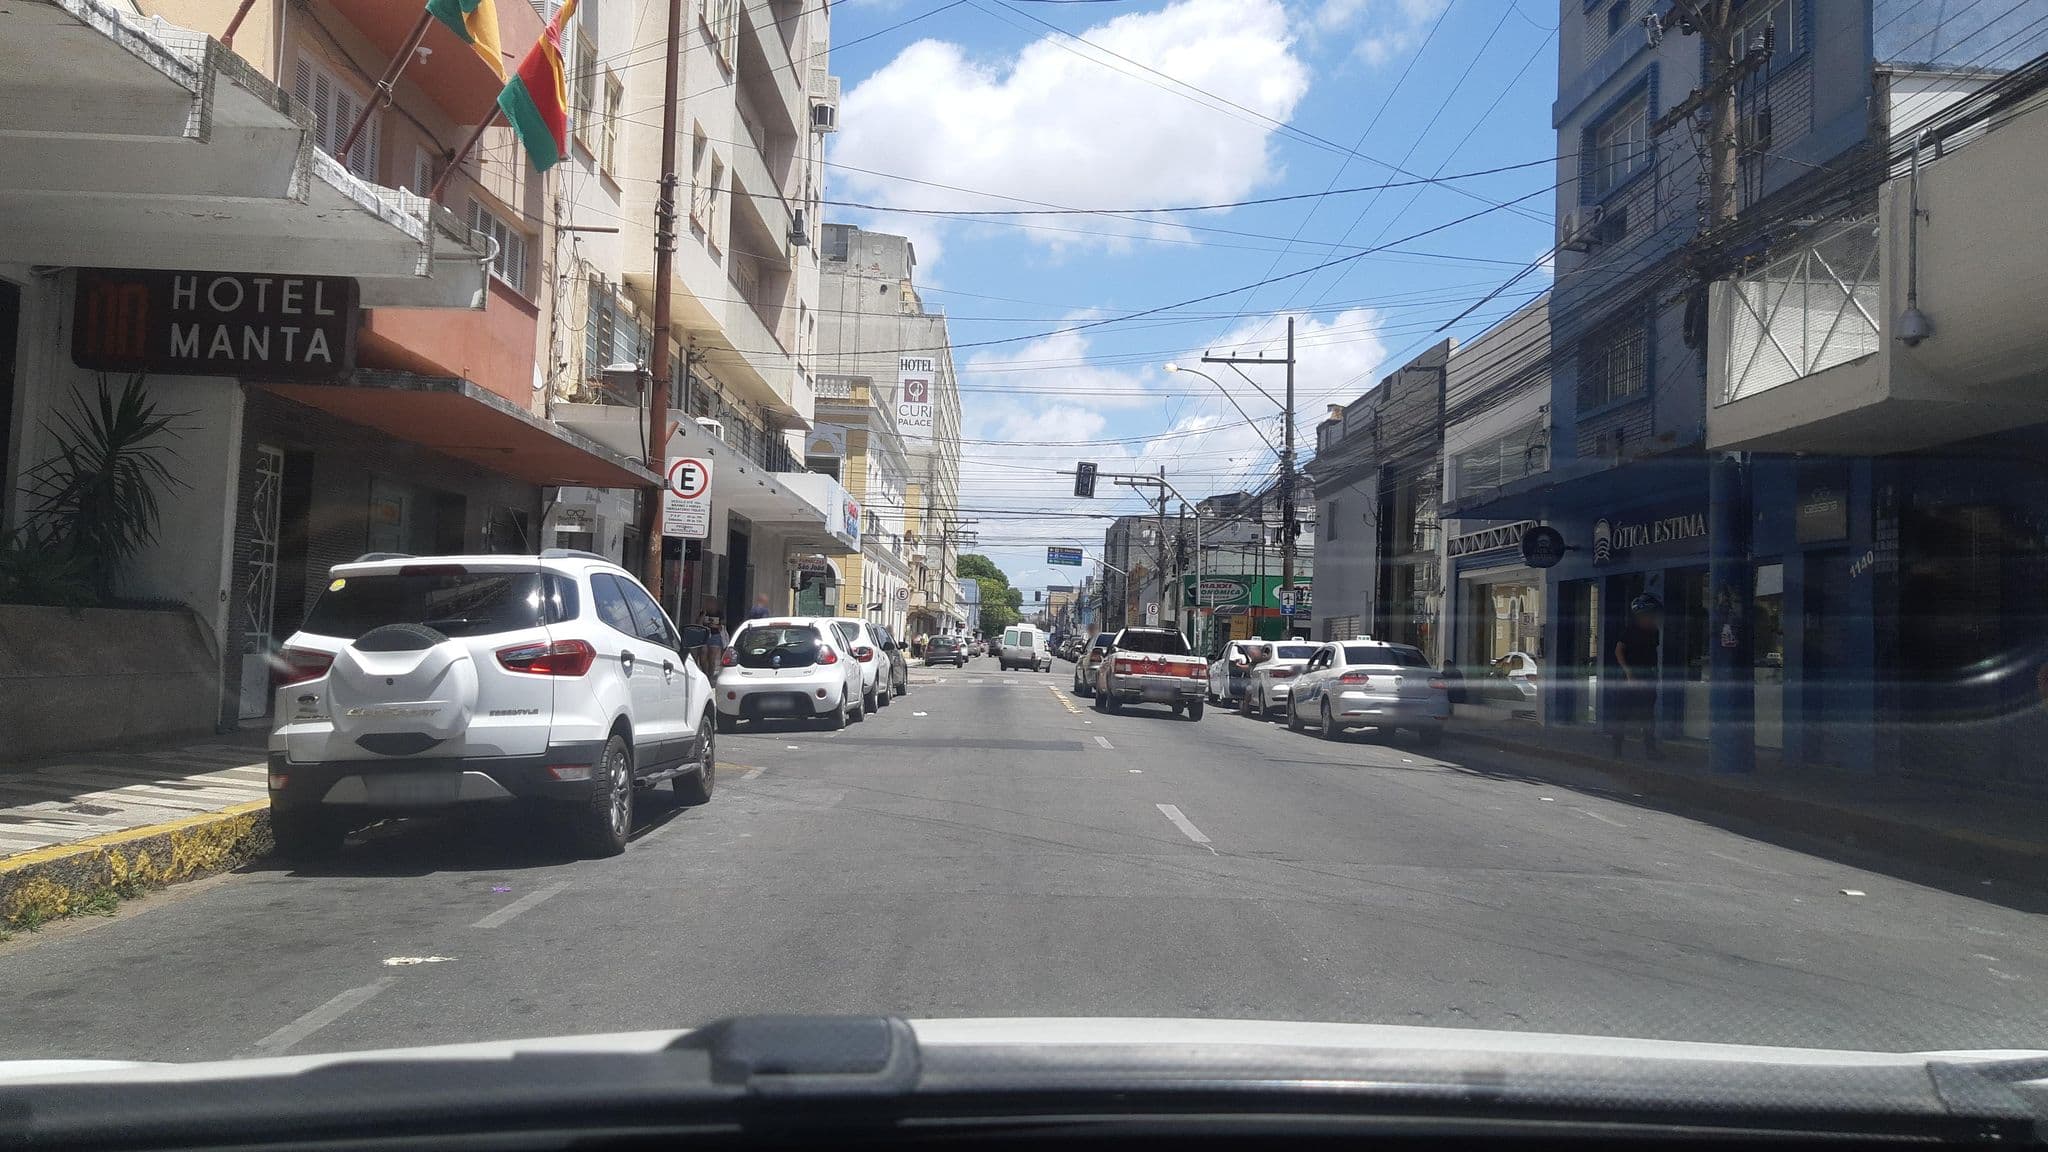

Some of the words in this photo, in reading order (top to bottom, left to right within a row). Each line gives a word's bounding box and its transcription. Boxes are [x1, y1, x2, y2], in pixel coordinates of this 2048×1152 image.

[172, 275, 336, 316] HOTEL
[169, 322, 333, 364] MANTA
[899, 358, 934, 372] HOTEL
[898, 404, 933, 418] CURI
[898, 418, 933, 427] PALACE
[680, 468, 696, 491] E
[1613, 520, 1650, 550] ÓTICA
[1653, 512, 1707, 543] ESTIMA
[1848, 549, 1874, 579] 1140
